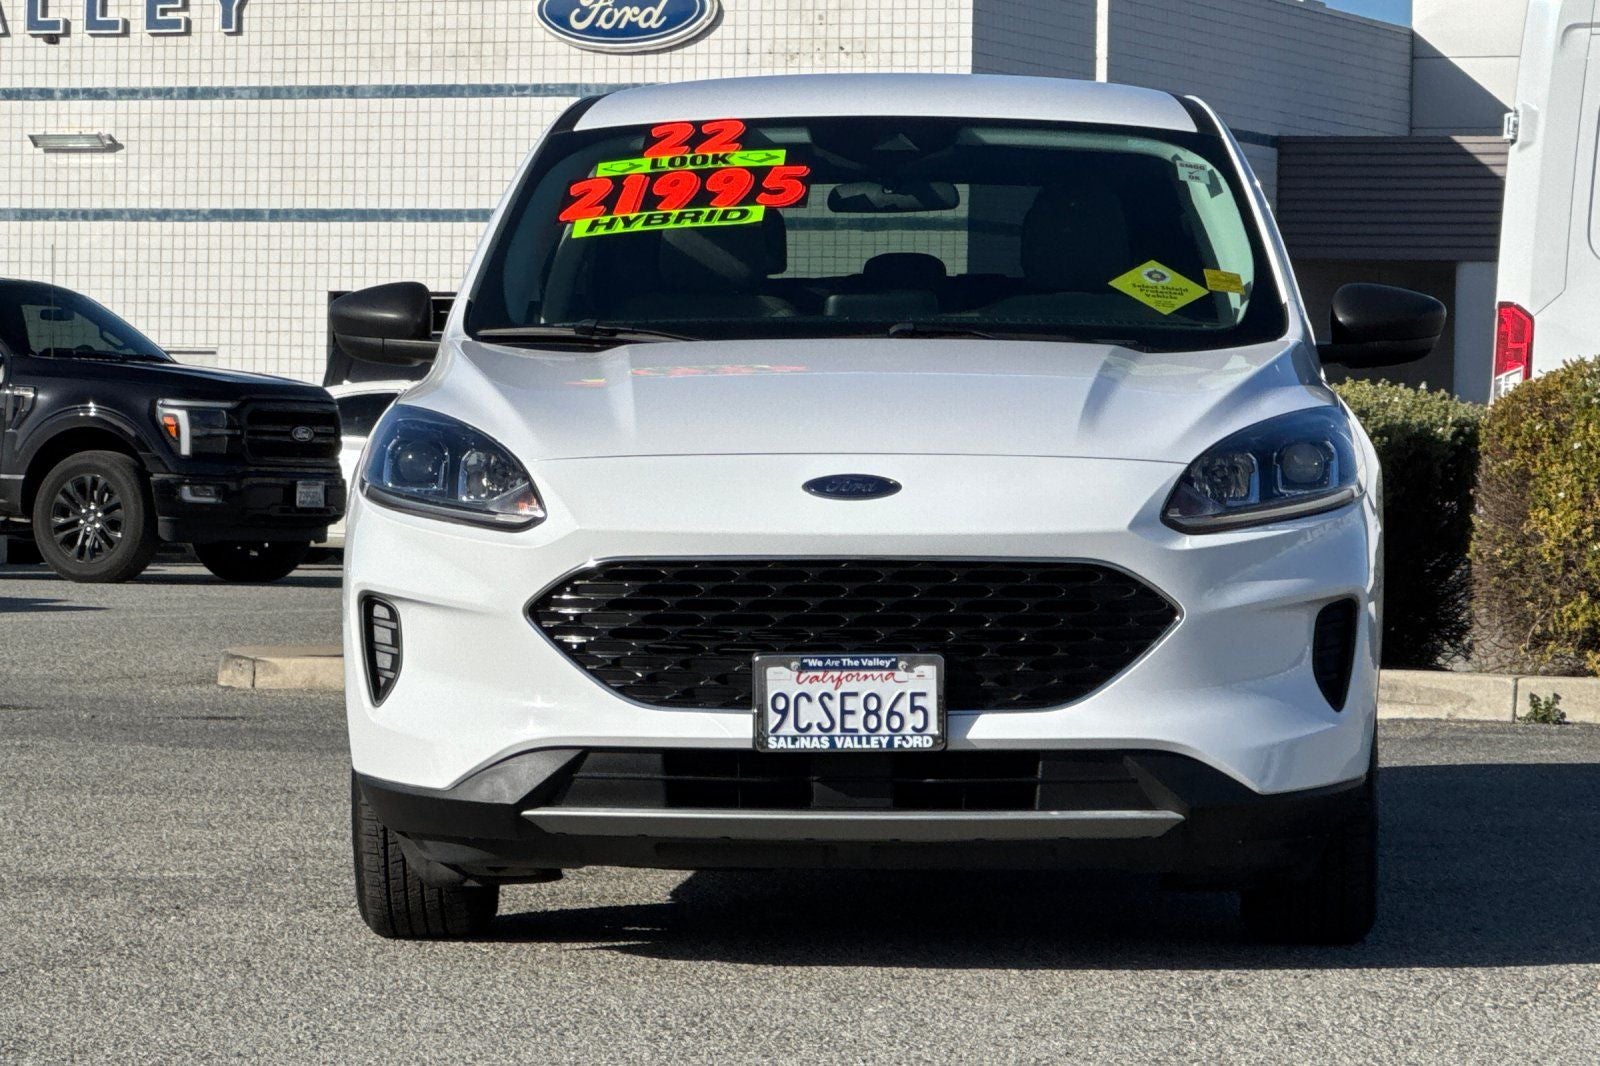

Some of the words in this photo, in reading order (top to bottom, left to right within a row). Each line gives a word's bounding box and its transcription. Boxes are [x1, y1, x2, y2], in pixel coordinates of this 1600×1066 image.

[0, 0, 244, 34] LLEY
[569, 0, 667, 30] Ford
[644, 118, 746, 157] 22
[650, 152, 735, 170] LOOK
[558, 166, 810, 222] 21995
[585, 207, 753, 234] HYBRID
[825, 658, 840, 667] Are
[841, 658, 859, 667] The
[795, 671, 909, 691] California
[770, 691, 929, 734] 9CSE865
[834, 736, 888, 749] VALLEY
[893, 736, 933, 748] FORD
